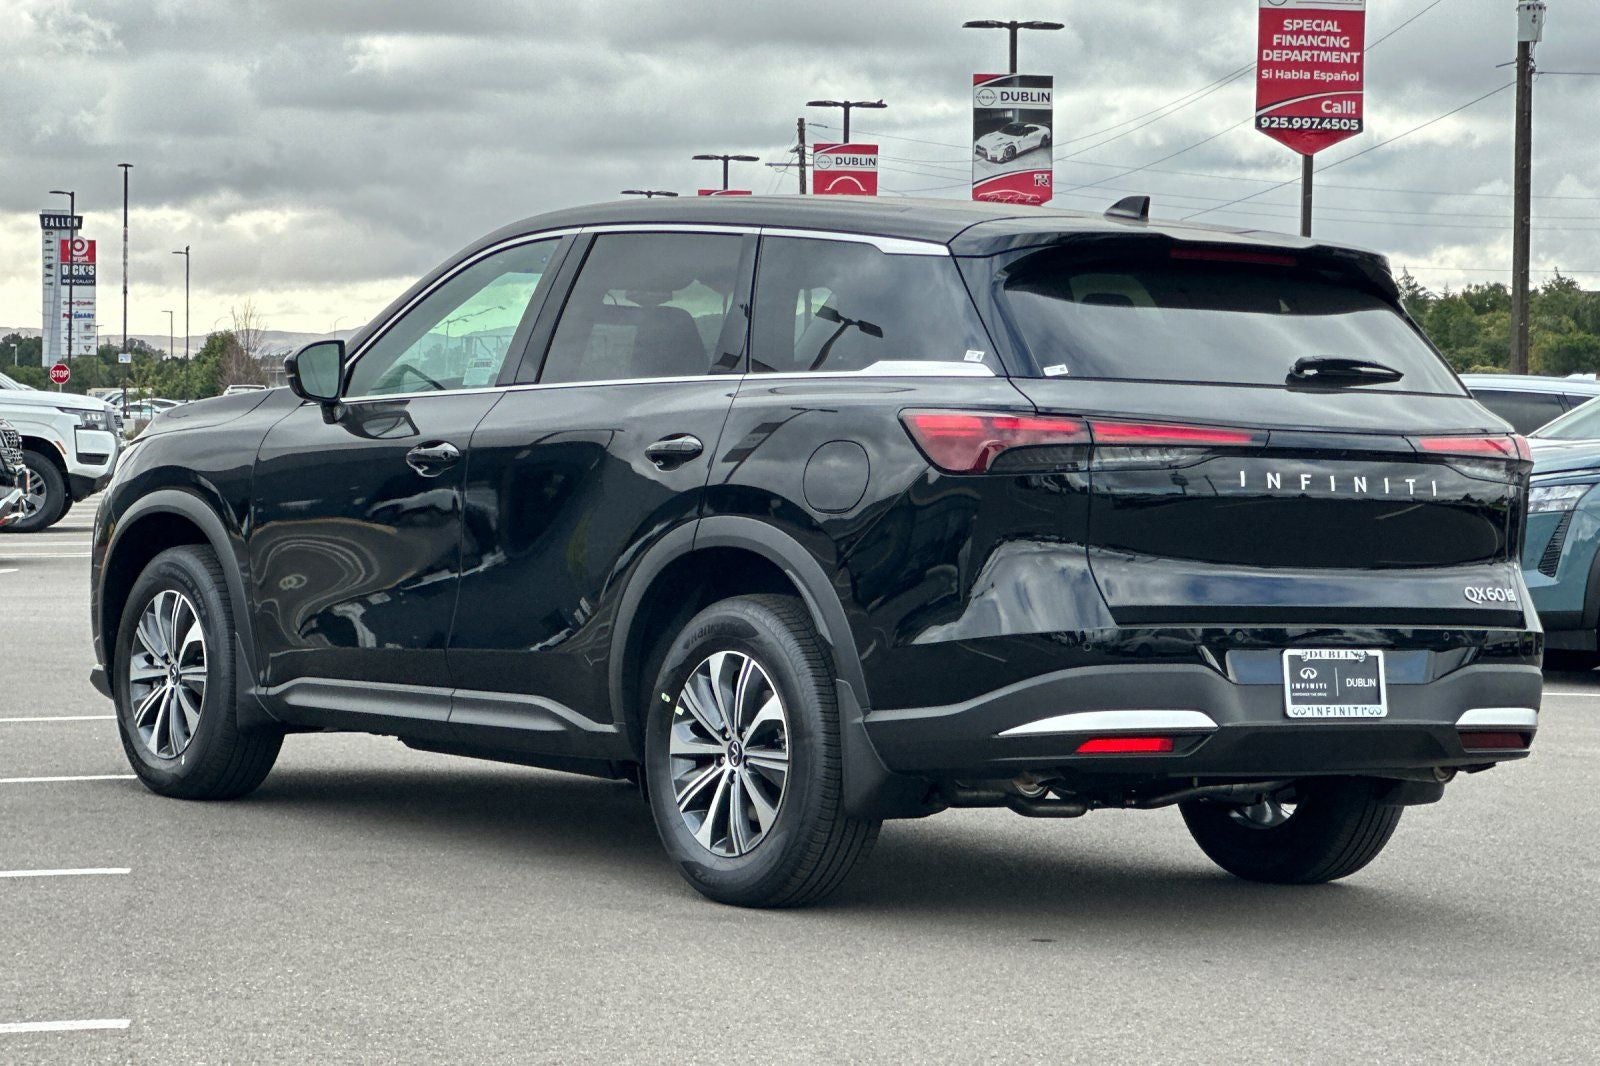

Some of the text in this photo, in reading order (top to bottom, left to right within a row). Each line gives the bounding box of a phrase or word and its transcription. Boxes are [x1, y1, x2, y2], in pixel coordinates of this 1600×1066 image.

[1283, 19, 1341, 32] SPECIAL
[1273, 34, 1350, 48] FINANCING
[1262, 49, 1360, 63] DEPARTMENT
[1261, 69, 1360, 82] Si Habla Español
[1000, 91, 1050, 102] DUBLIN
[1321, 100, 1356, 114] Call!
[1261, 117, 1359, 130] 925.997.4505
[835, 157, 876, 166] DUBLIN
[44, 217, 79, 227] FALLON
[51, 370, 69, 378] STOP
[1240, 471, 1437, 497] INFINITI
[1291, 682, 1327, 690] INFINITI
[1345, 678, 1377, 687] DUBLIN
[1311, 706, 1365, 716] INFINITI
